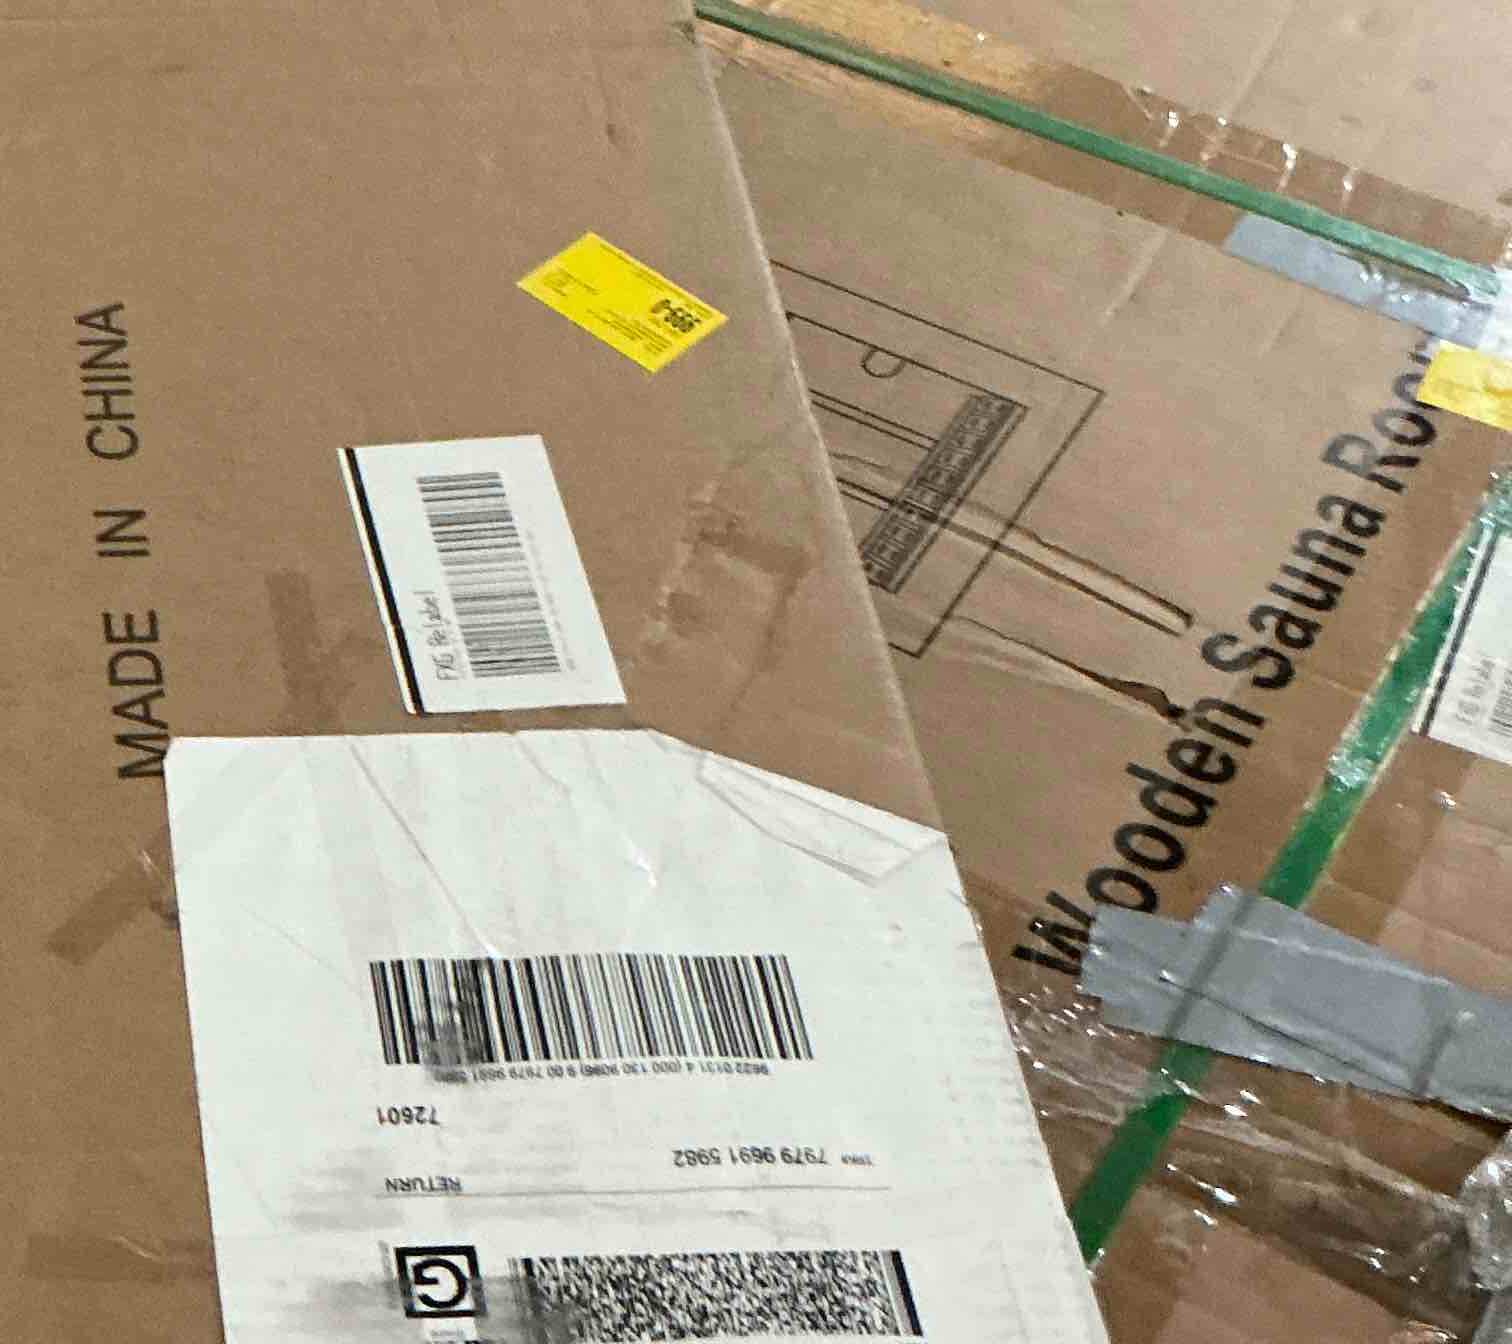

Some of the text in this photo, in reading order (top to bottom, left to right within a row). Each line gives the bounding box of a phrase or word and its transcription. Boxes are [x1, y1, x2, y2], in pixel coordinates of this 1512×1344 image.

[72, 302, 170, 781] MADE IN CHINA
[1011, 339, 1438, 976] Wooden Sauna Roo
[375, 1104, 441, 1127] 72601
[671, 1146, 724, 1169] 5982
[727, 1146, 777, 1166] 9691
[779, 1146, 832, 1166] 7979
[384, 1175, 464, 1194] RETURN
[410, 1257, 469, 1311] G
